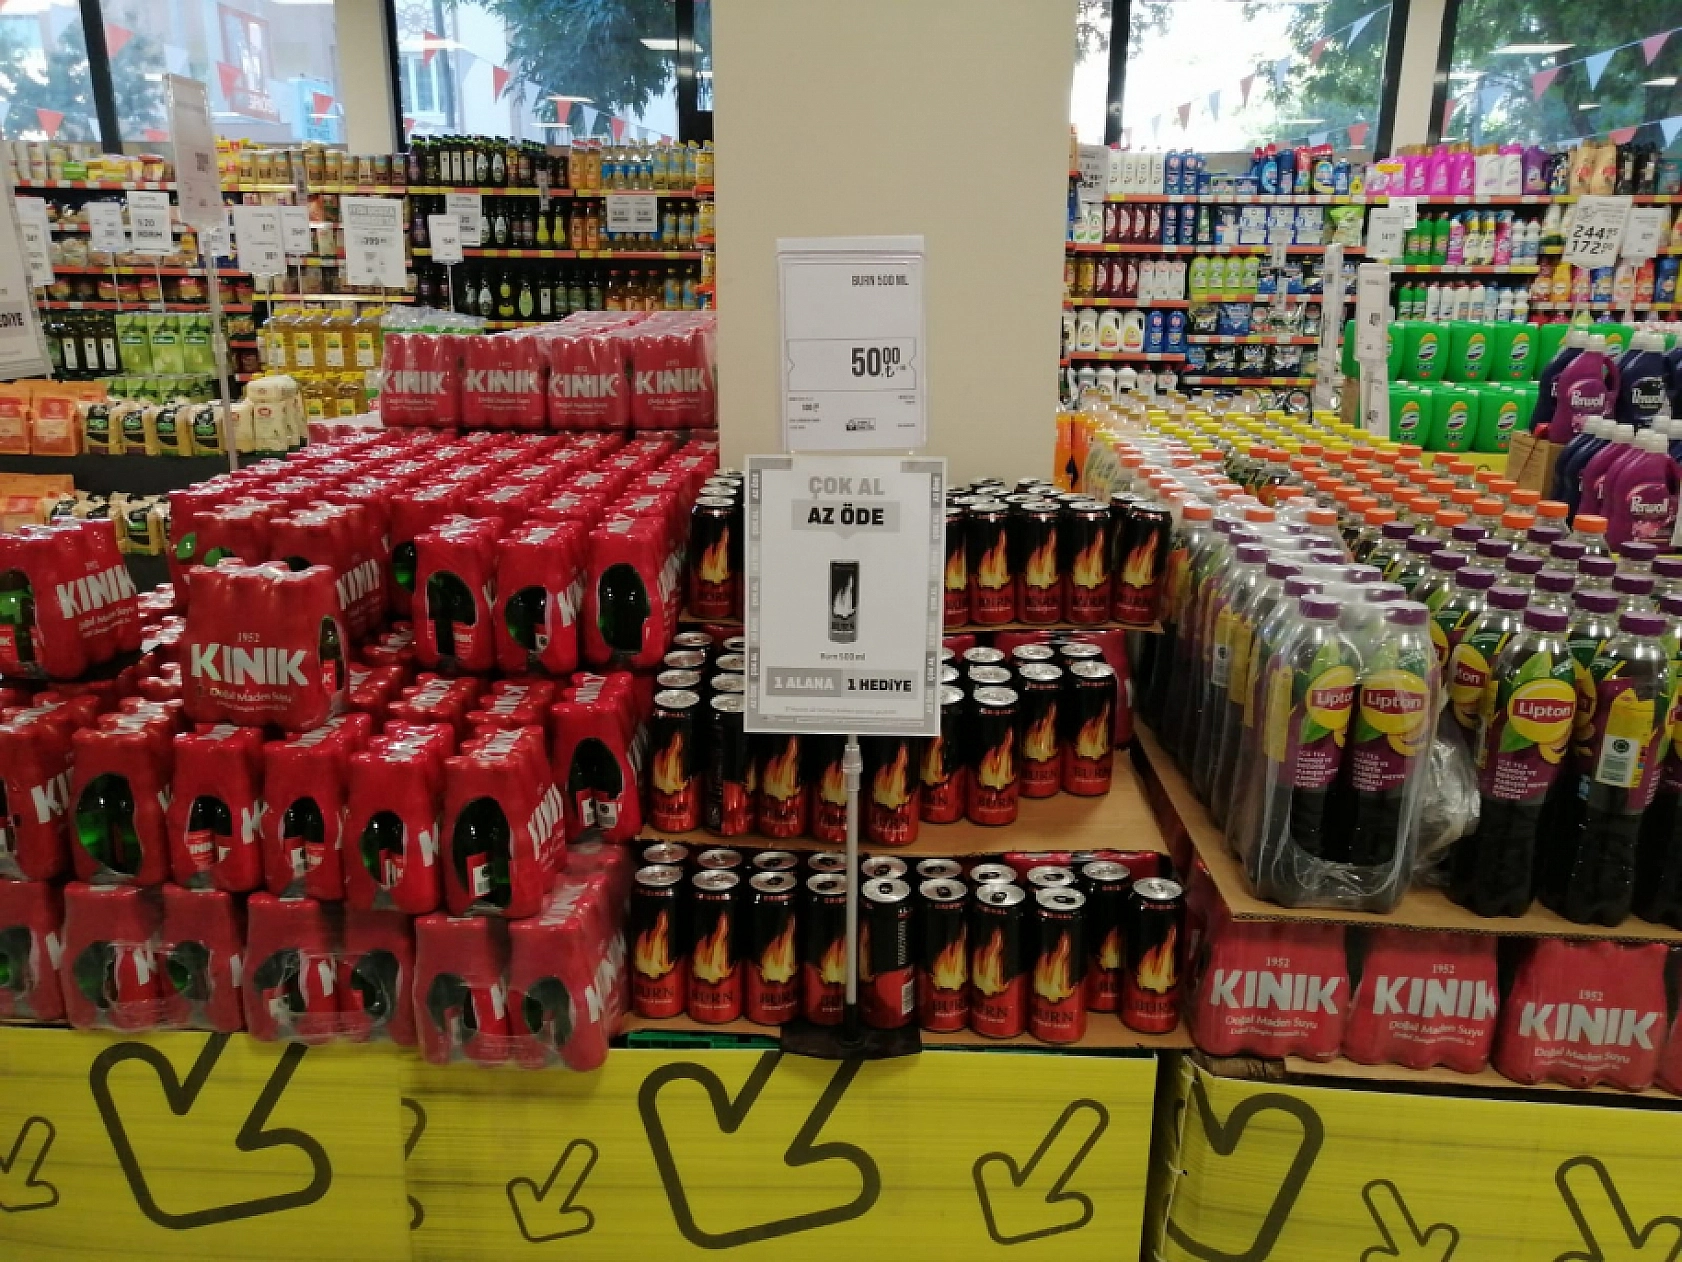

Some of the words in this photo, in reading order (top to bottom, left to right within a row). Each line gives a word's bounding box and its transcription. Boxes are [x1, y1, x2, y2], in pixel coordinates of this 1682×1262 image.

[852, 275, 875, 287] BURN
[877, 275, 895, 286] 500
[896, 275, 910, 286] ML
[466, 369, 542, 395] KINIK
[635, 367, 708, 395] KINIK
[809, 475, 853, 500] ÇOK
[857, 477, 886, 496] AL
[807, 507, 835, 525] AZ
[840, 501, 885, 526] ÖDE
[56, 564, 137, 619] KINIK
[190, 642, 310, 687] KINIK
[773, 676, 784, 690] 1
[785, 676, 835, 691] ALANA
[847, 677, 857, 691] 1
[1316, 690, 1354, 708] Lipto
[1367, 691, 1422, 710] Lipton
[1518, 701, 1571, 719] Lipton
[1265, 956, 1290, 968] 1952
[1431, 963, 1455, 974] 1952
[1210, 968, 1342, 1015] KINIK
[1518, 1002, 1660, 1051] KINIK
